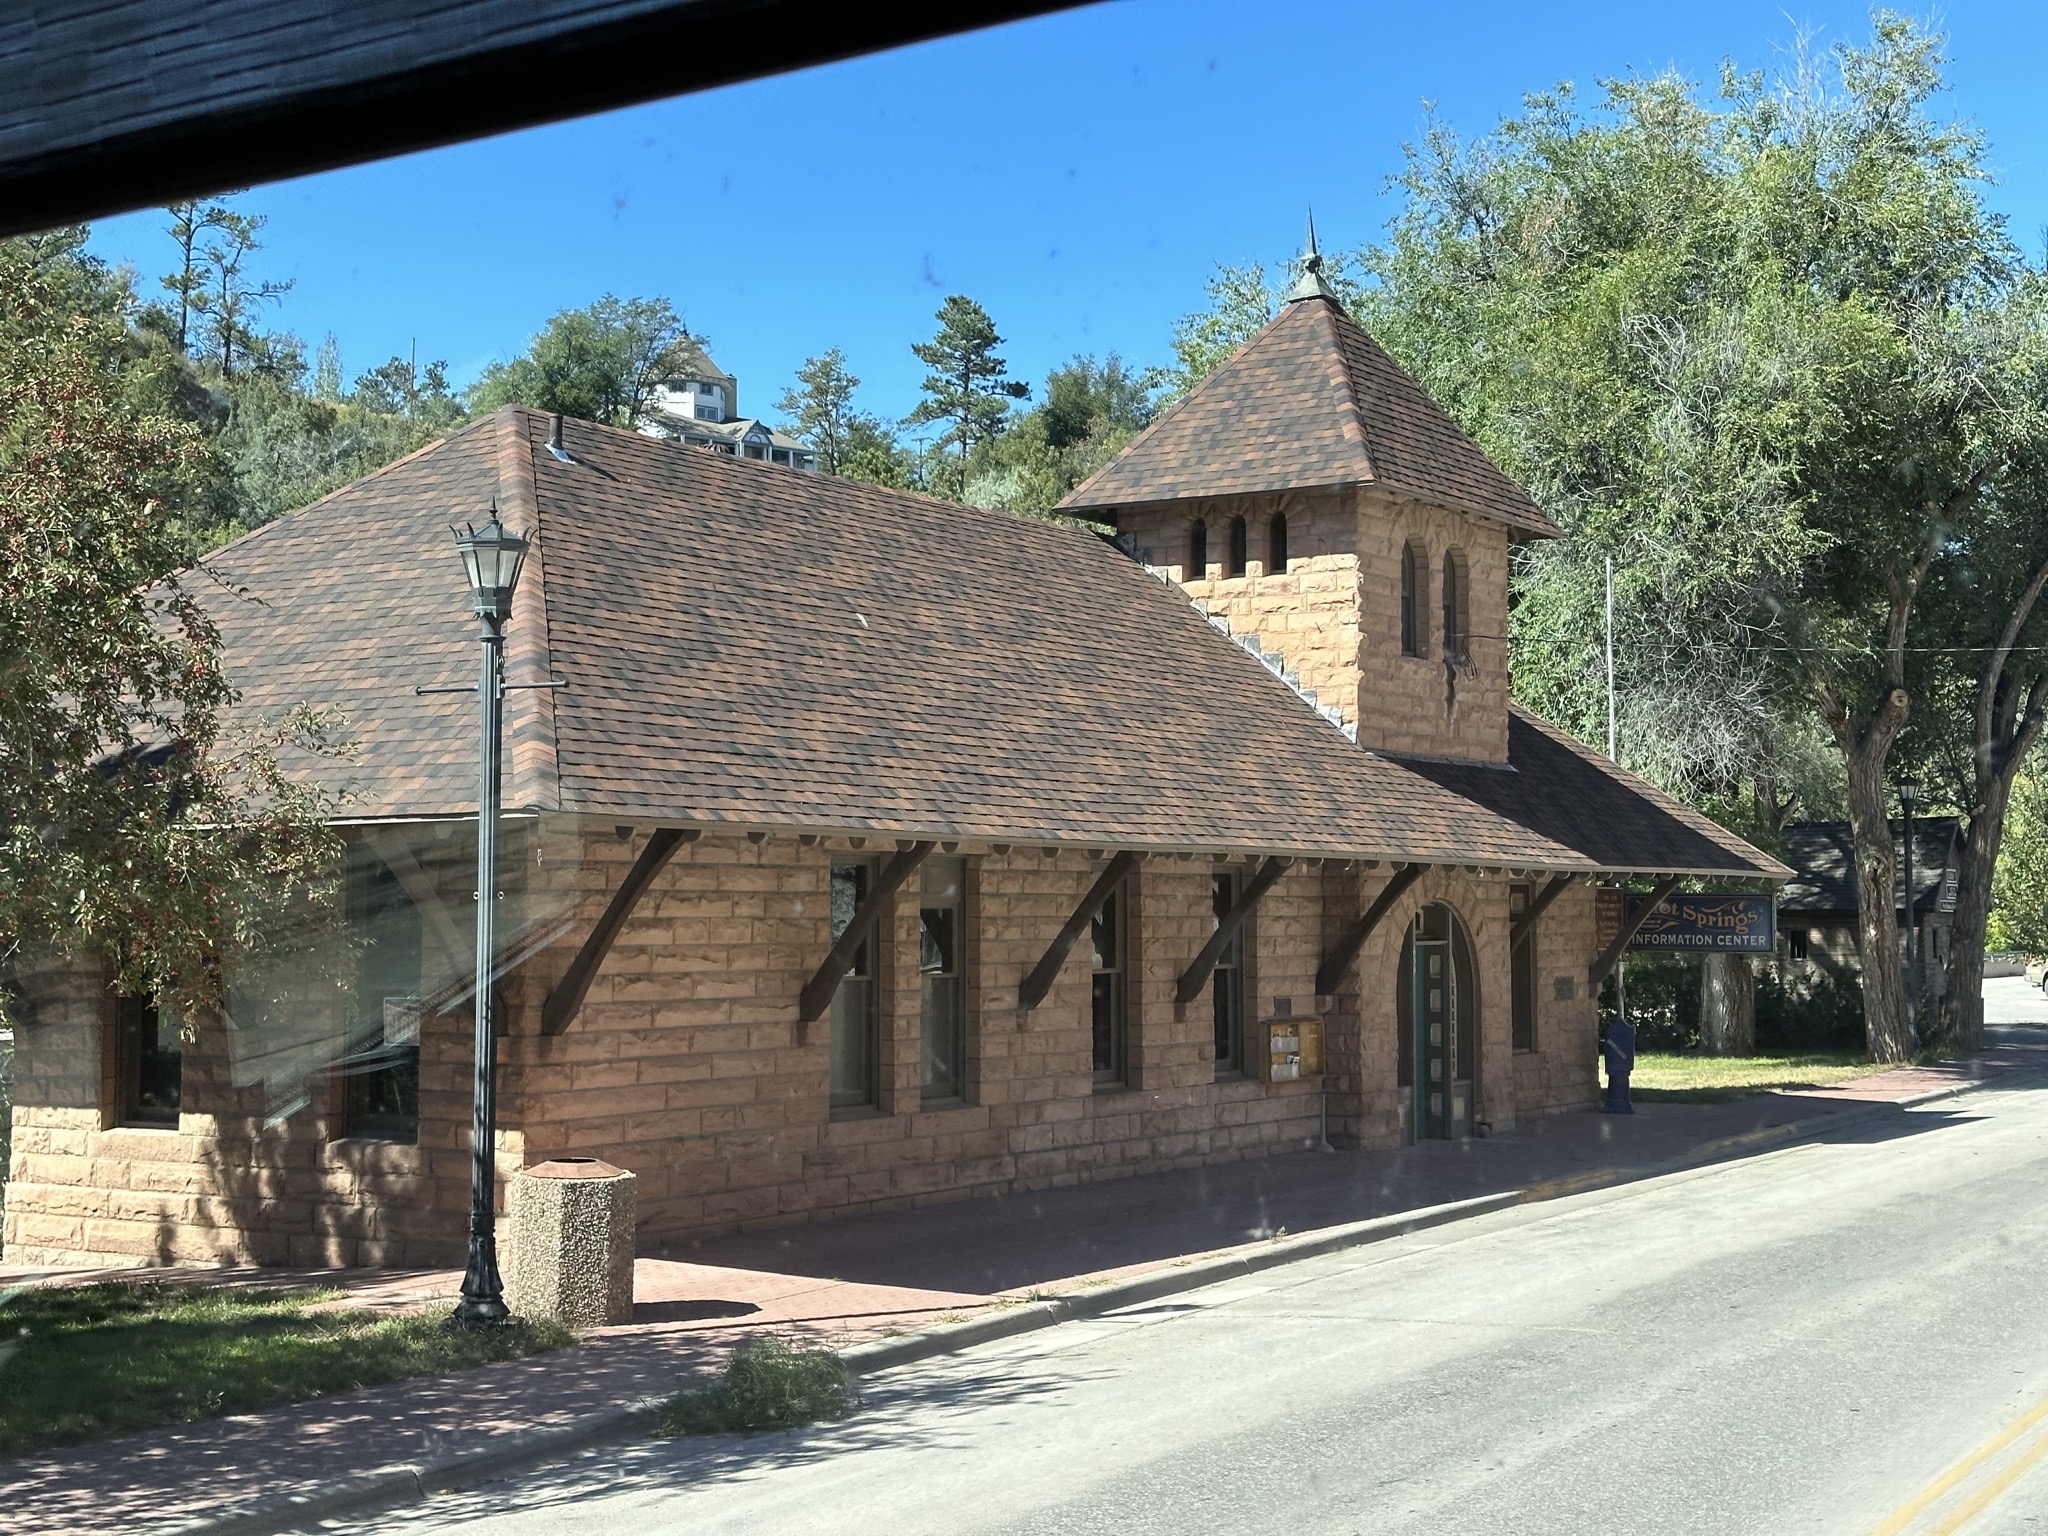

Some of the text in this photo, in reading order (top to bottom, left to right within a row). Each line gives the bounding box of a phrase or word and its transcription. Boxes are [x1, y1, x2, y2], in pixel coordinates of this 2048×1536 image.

[1682, 904, 1758, 935] Springs
[1631, 933, 1713, 946] INFORMATION
[1716, 934, 1767, 946] CENTER
